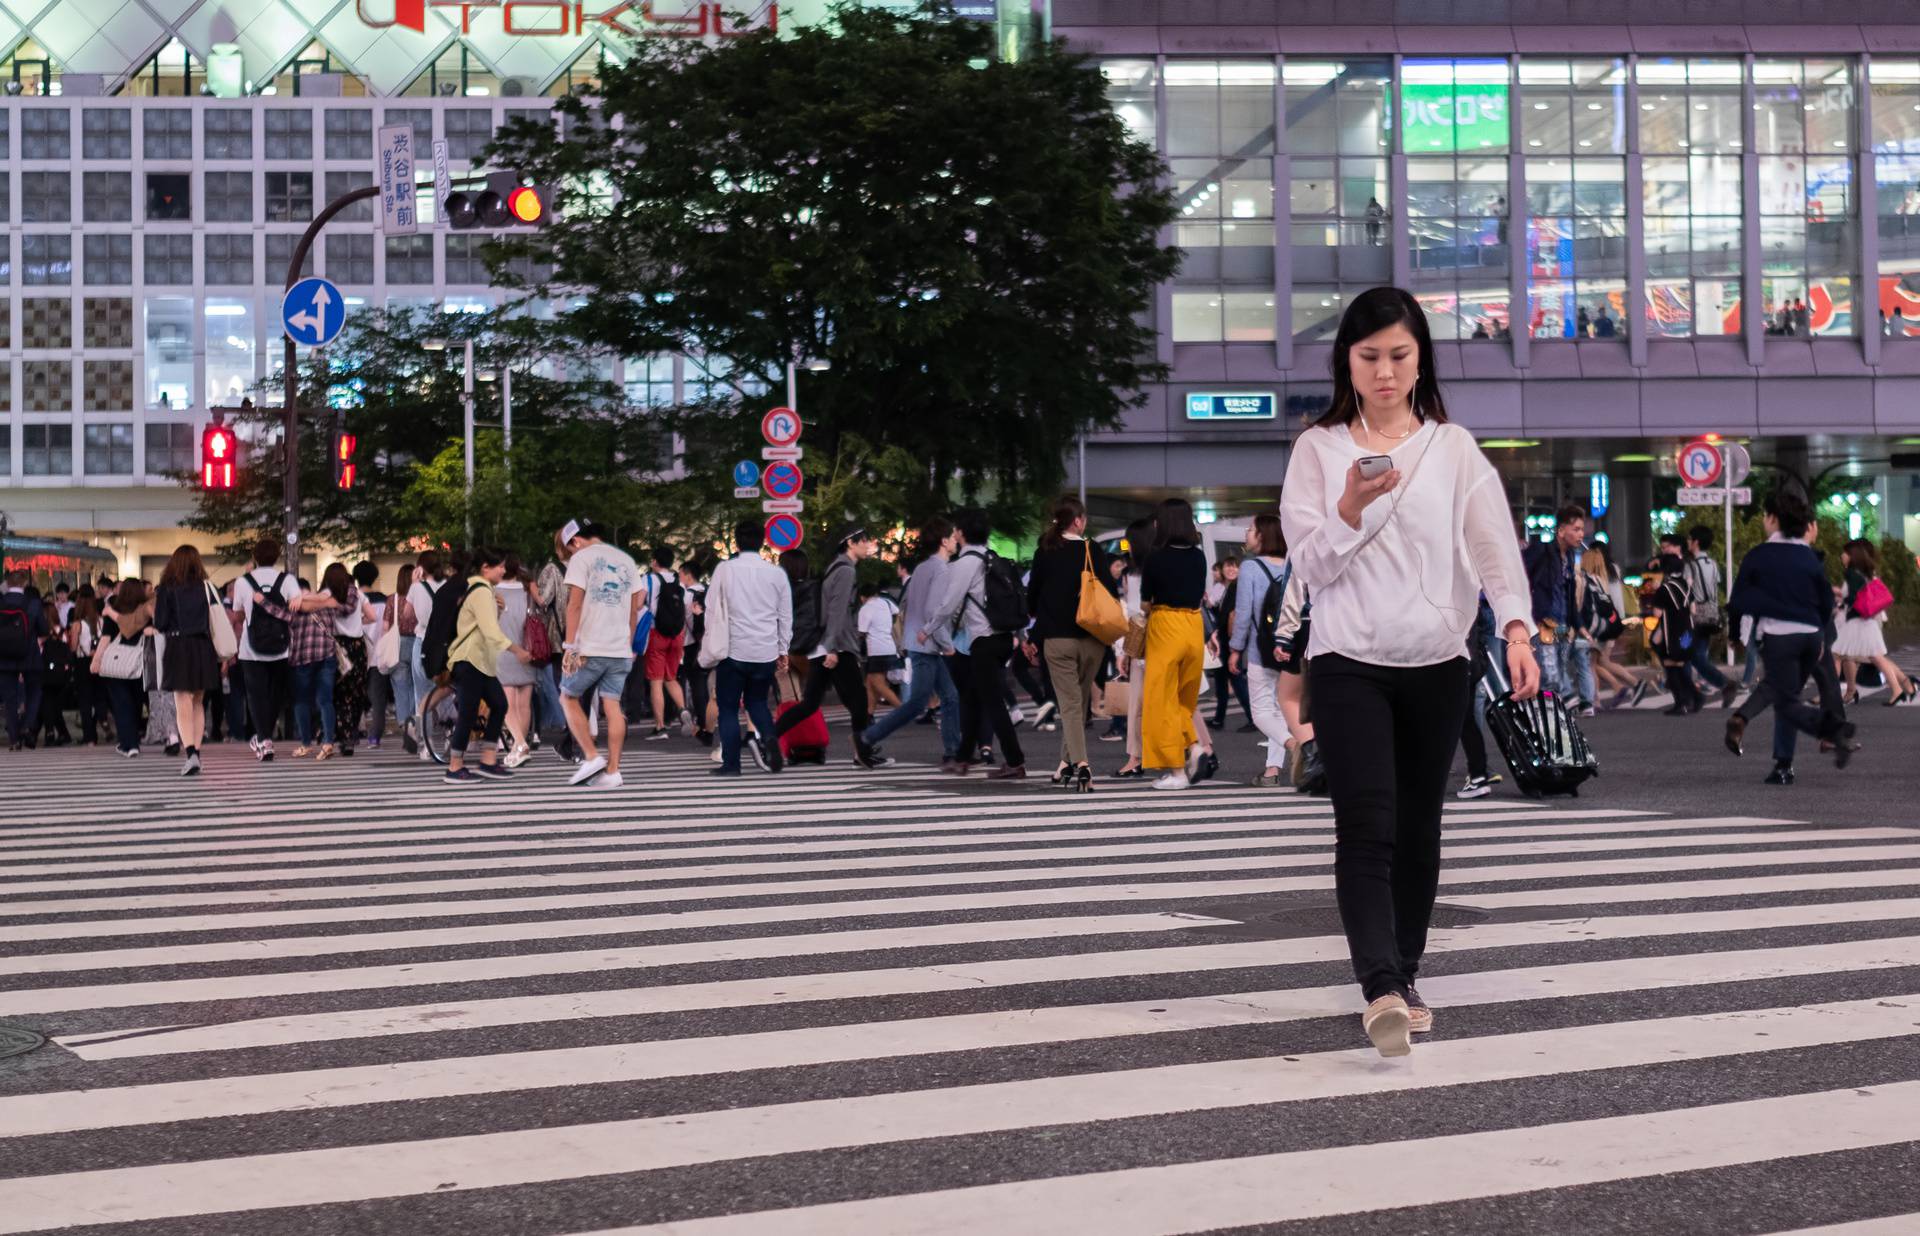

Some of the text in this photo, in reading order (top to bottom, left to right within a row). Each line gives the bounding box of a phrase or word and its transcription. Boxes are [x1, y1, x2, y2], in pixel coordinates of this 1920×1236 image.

[383, 149, 393, 192] Shibuya
[393, 133, 413, 226] 渋谷駅前
